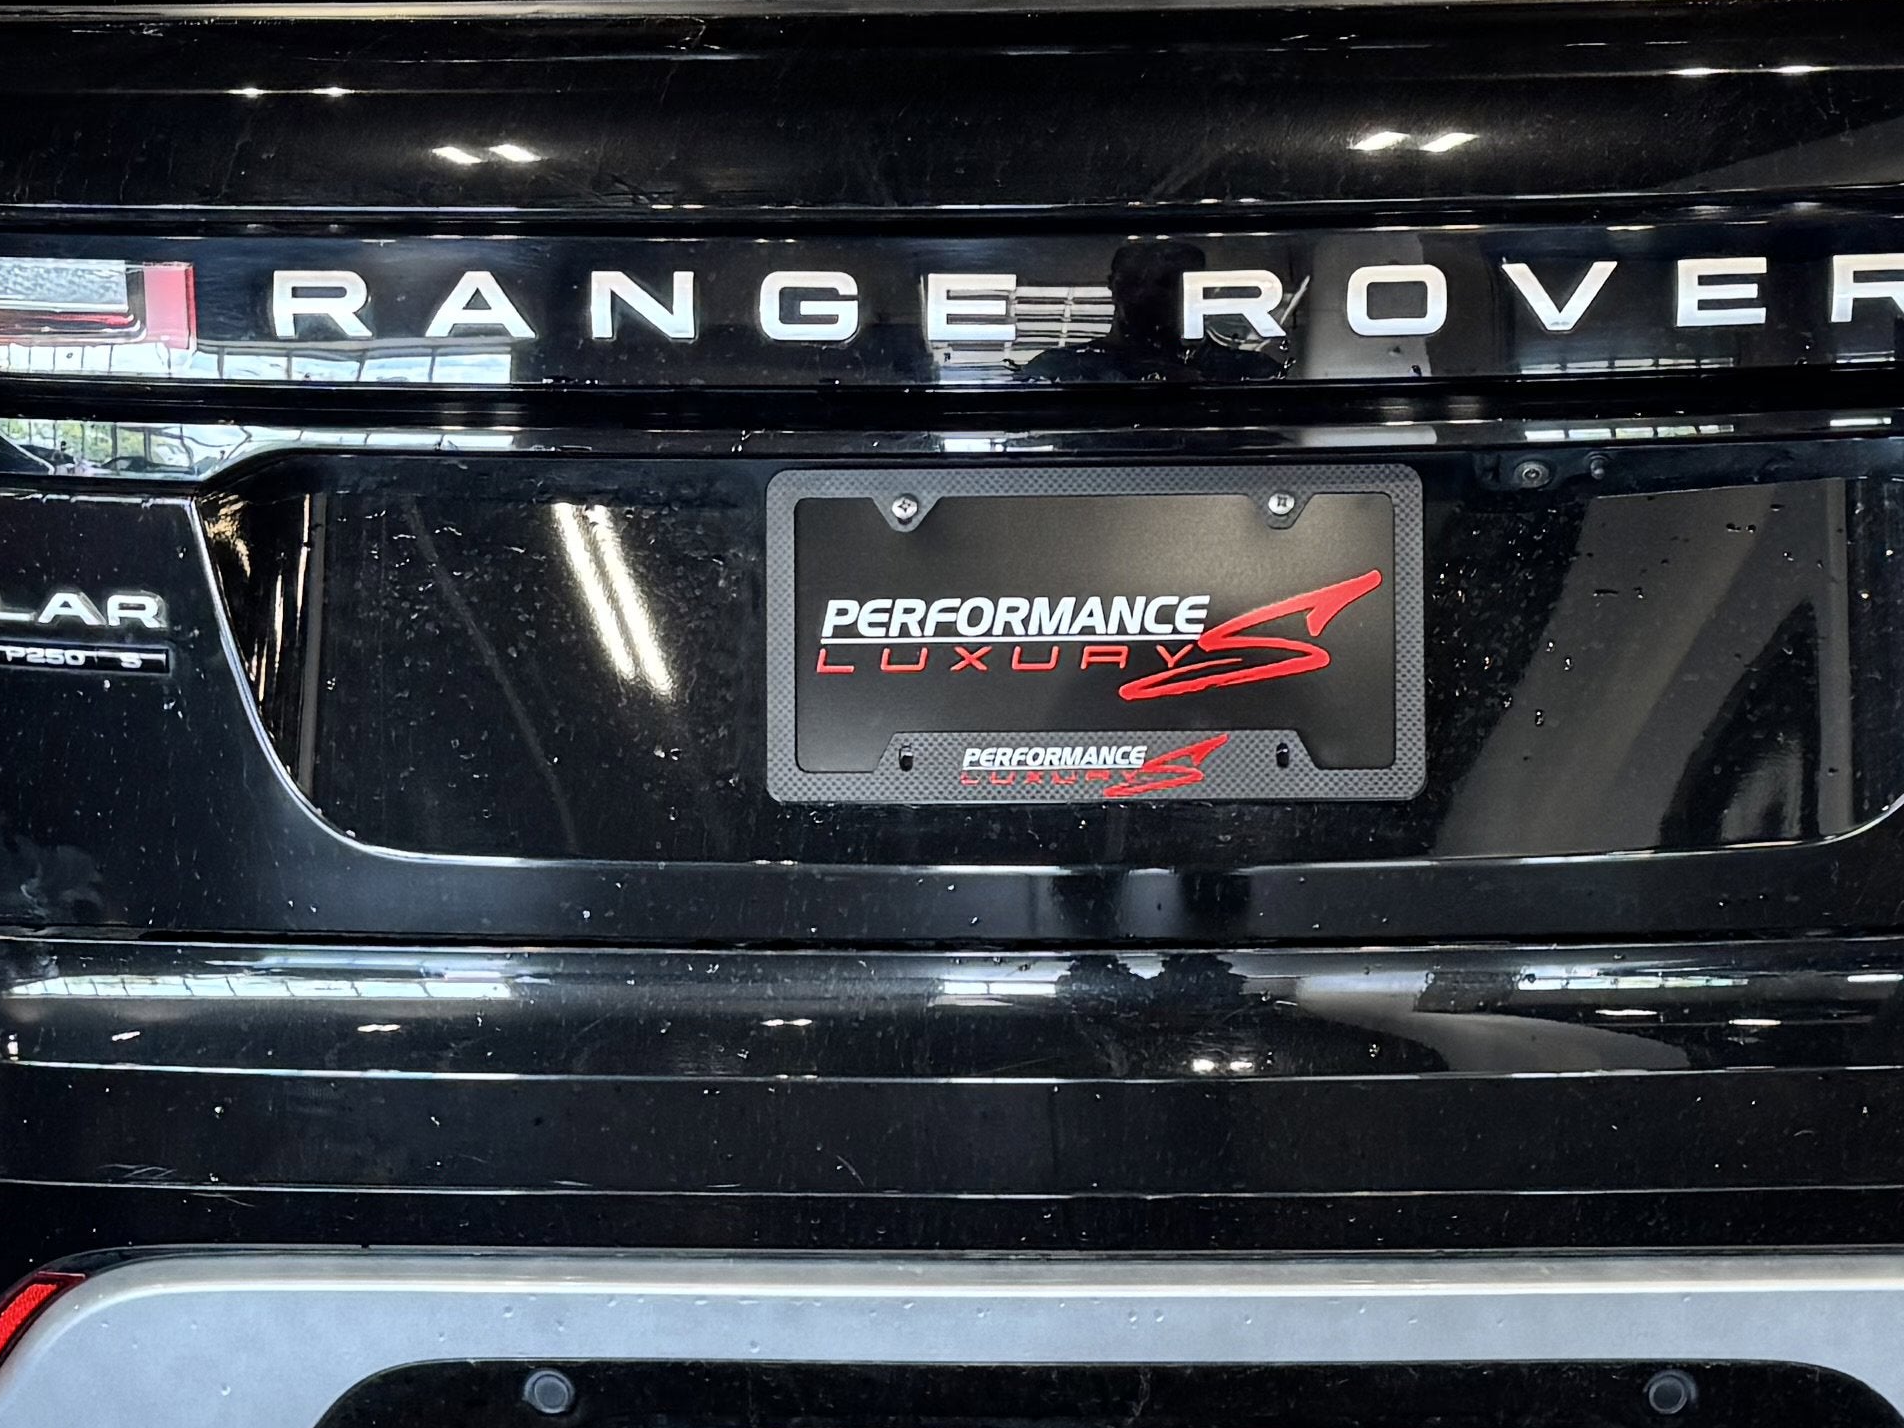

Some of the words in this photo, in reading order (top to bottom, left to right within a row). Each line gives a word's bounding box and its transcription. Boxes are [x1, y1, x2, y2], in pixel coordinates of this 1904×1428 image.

[271, 269, 1017, 341] RANGE
[820, 594, 1211, 638] PERFORMANCE
[3, 647, 87, 667] P250
[816, 644, 1195, 674] LUXURY
[962, 746, 1147, 768] PERFORMANCE
